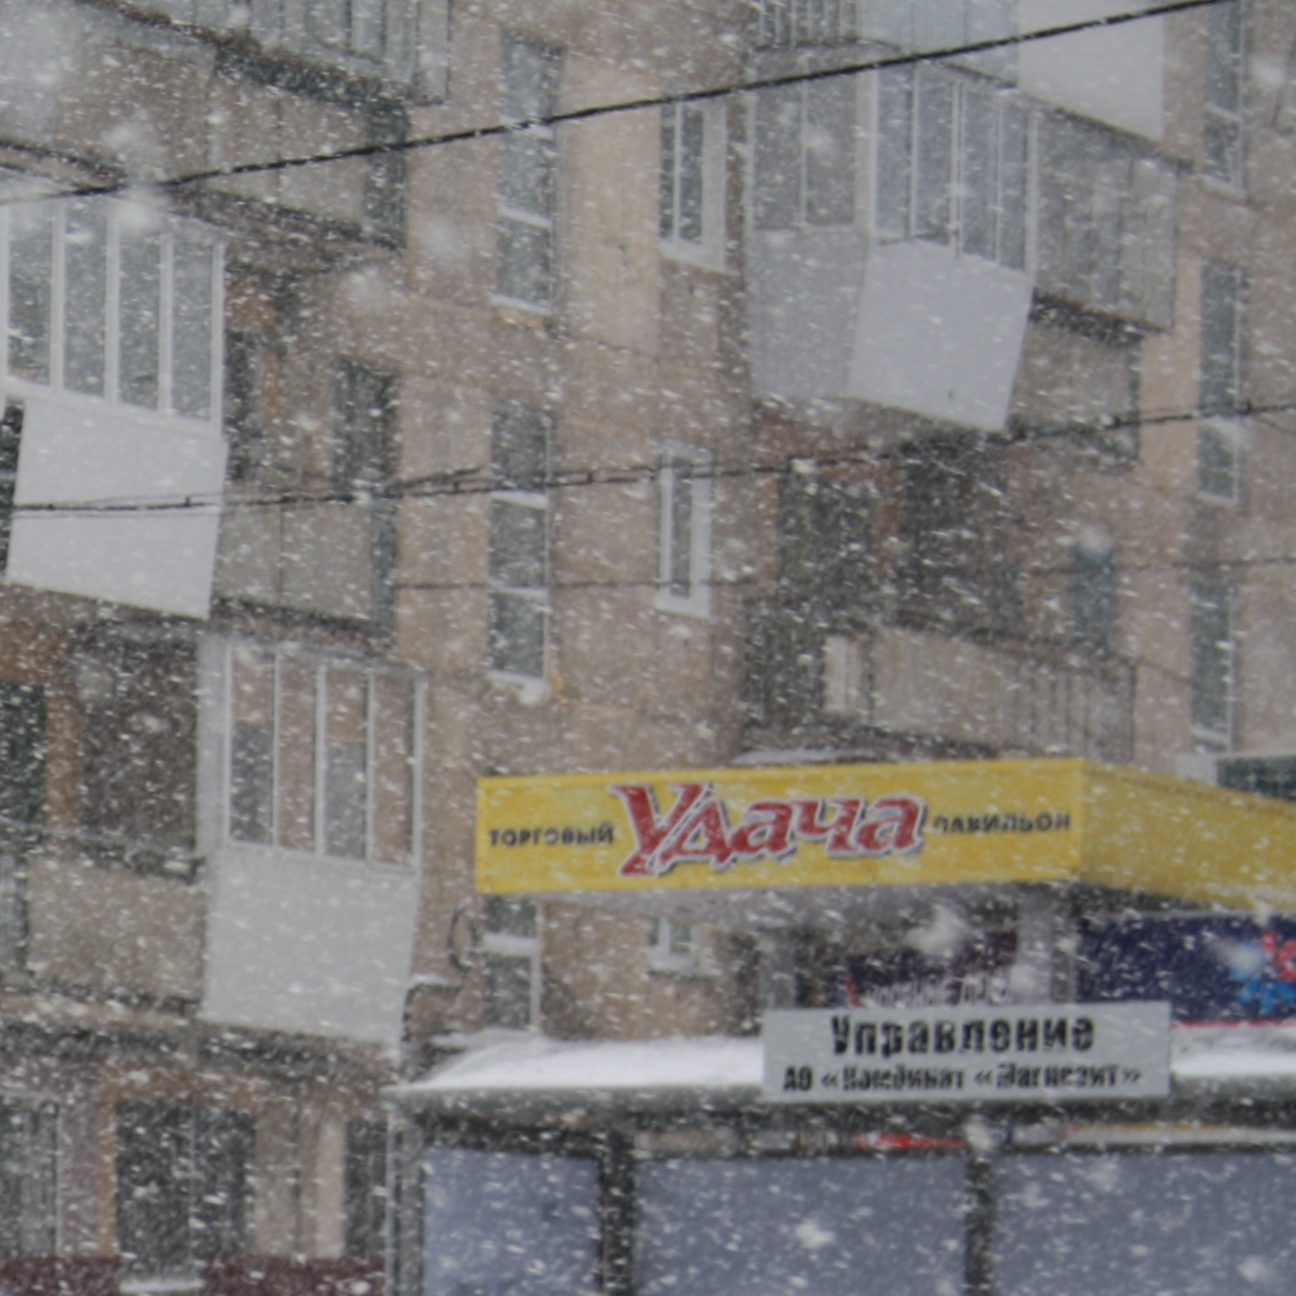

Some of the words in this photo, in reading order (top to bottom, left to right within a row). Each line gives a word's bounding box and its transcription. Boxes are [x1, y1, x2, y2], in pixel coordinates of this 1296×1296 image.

[489, 820, 615, 847] ТОРГОВЫЙ
[933, 812, 1070, 833] ПАВИЛЬОН
[830, 1014, 1097, 1059] Управление
[783, 1065, 814, 1093] АО
